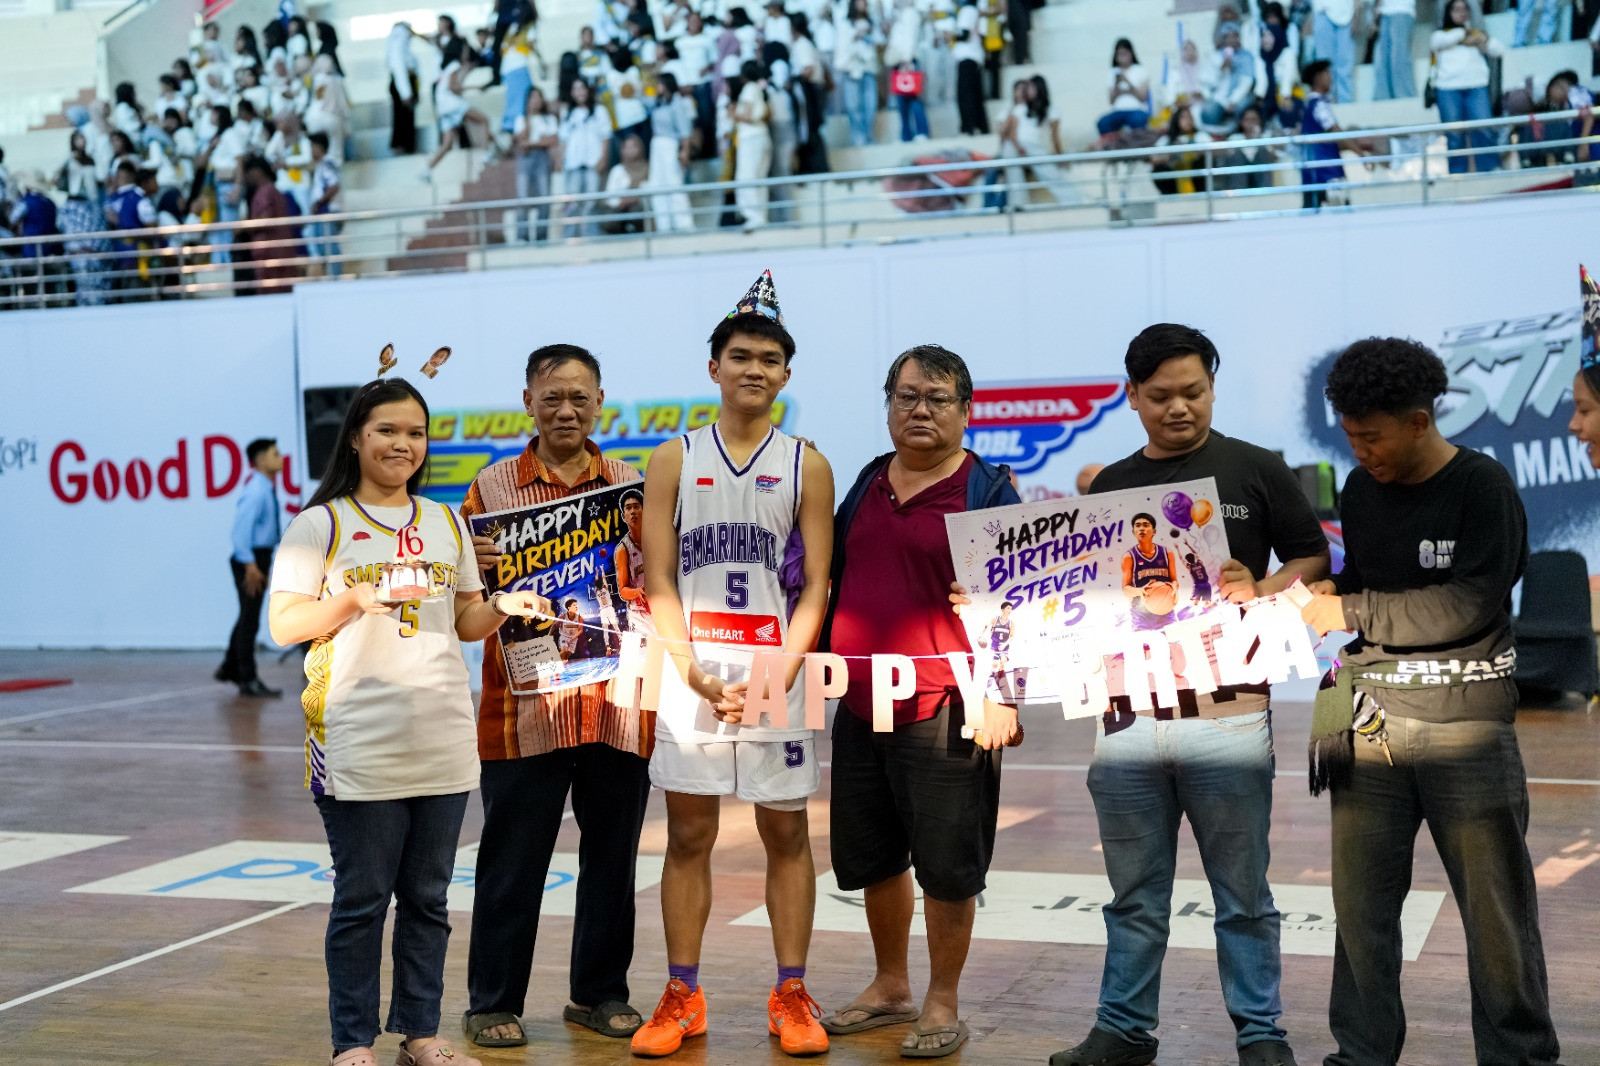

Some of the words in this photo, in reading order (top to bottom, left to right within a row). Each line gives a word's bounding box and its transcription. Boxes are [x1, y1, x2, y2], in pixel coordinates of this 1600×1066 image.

[640, 406, 682, 434] YA
[972, 398, 1080, 420] HONDA
[972, 429, 1026, 458] DBL
[49, 440, 189, 504] Good
[396, 525, 424, 558] 16
[495, 498, 586, 554] HAPPY
[995, 508, 1080, 556] HAPPY
[496, 508, 621, 588] BIRTHDAY!
[984, 519, 1125, 594] BIRTHDAY!
[725, 570, 749, 610] 5
[1004, 561, 1099, 610] STEVEN
[398, 600, 421, 639] 5
[692, 626, 710, 638] One
[711, 627, 745, 641] HEART.
[783, 739, 806, 769] 5
